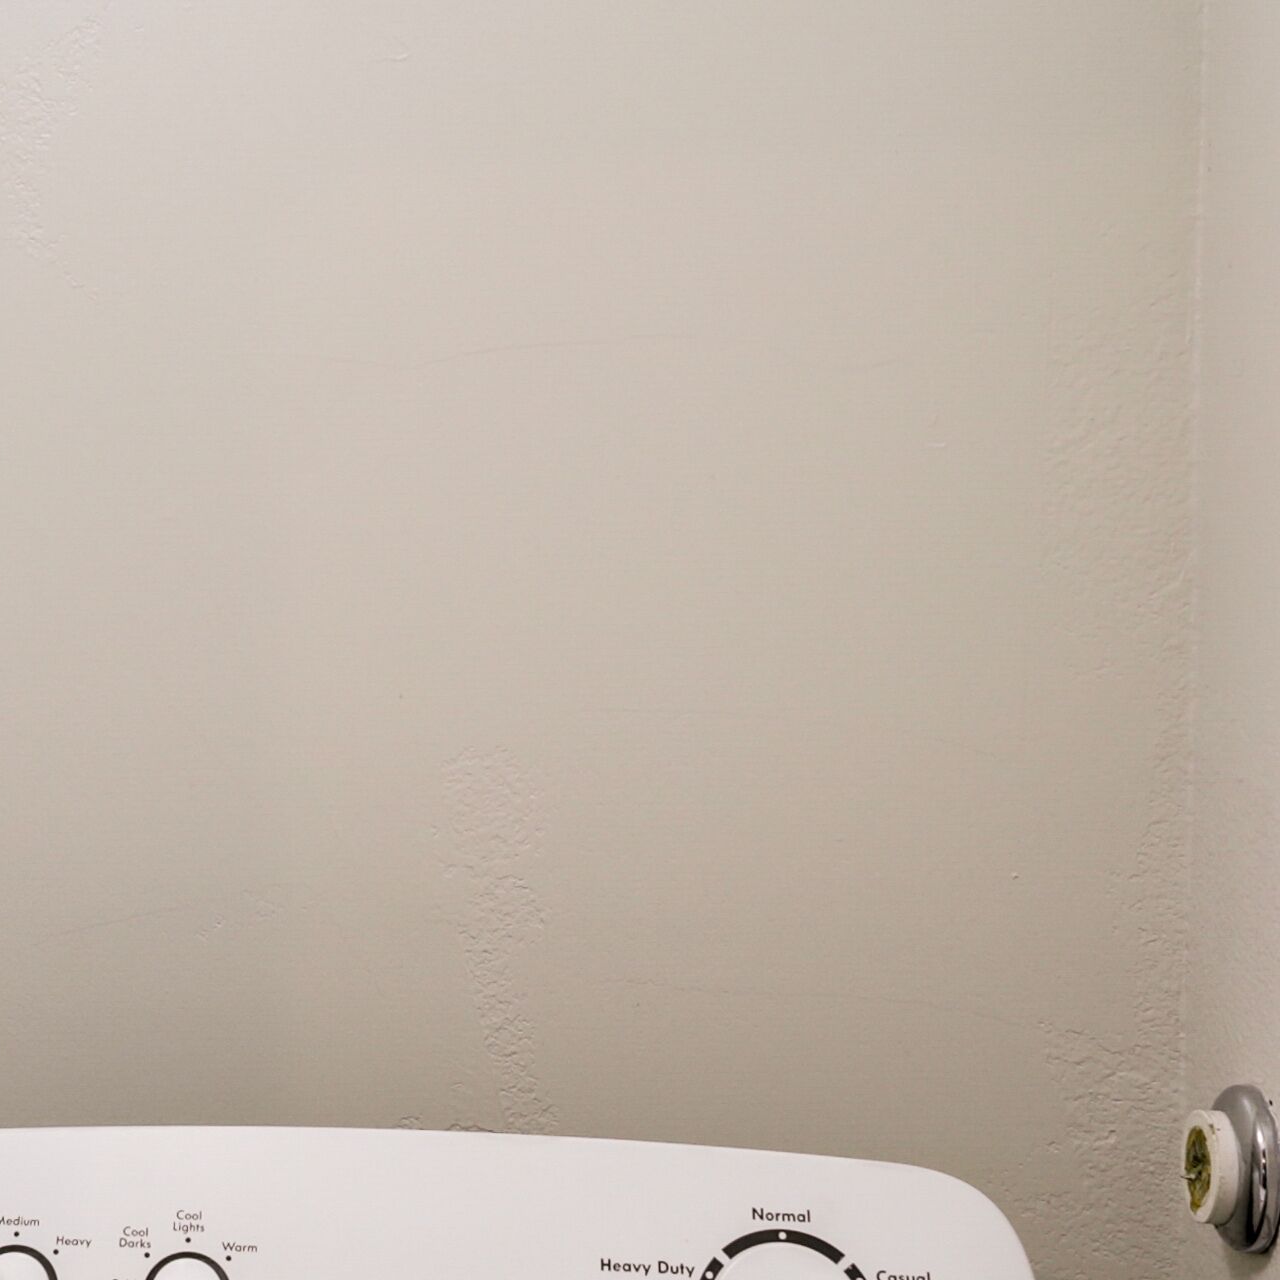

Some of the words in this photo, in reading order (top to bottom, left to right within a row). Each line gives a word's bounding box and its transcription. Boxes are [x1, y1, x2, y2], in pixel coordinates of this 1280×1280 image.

[176, 1210, 203, 1221] Cool
[751, 1207, 811, 1223] Normal
[123, 1226, 149, 1238] Cool
[172, 1221, 205, 1235] Lights
[55, 1235, 92, 1249] Heavy
[118, 1237, 152, 1250] Darks
[222, 1241, 258, 1254] Warm
[600, 1258, 651, 1276] Heavy
[657, 1260, 696, 1279] Duty
